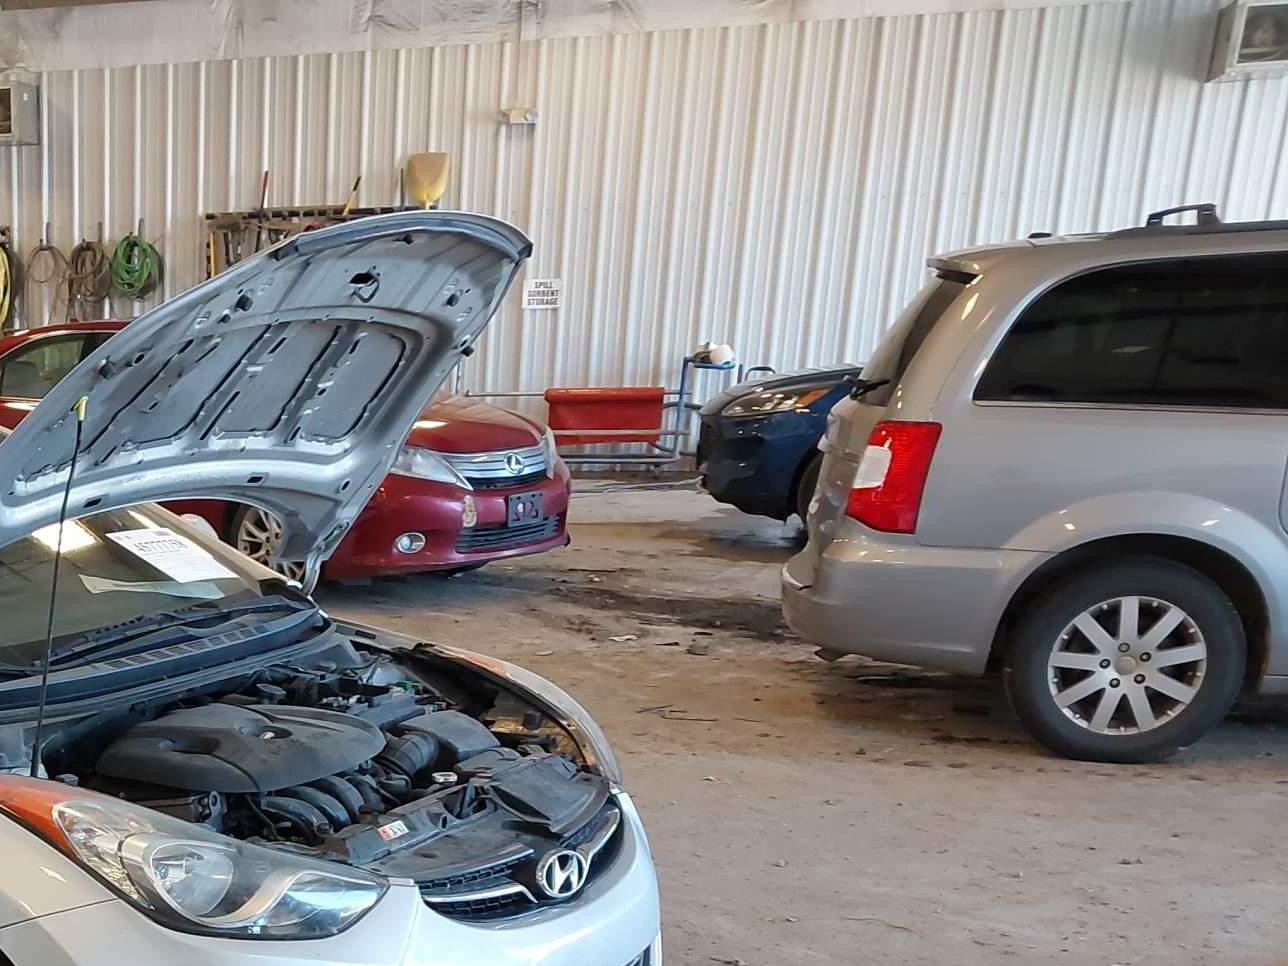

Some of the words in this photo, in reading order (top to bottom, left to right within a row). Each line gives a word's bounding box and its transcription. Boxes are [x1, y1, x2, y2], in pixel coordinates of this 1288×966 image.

[534, 281, 553, 289] SPILL
[527, 289, 560, 297] SORBENT
[527, 298, 559, 306] STORAGE
